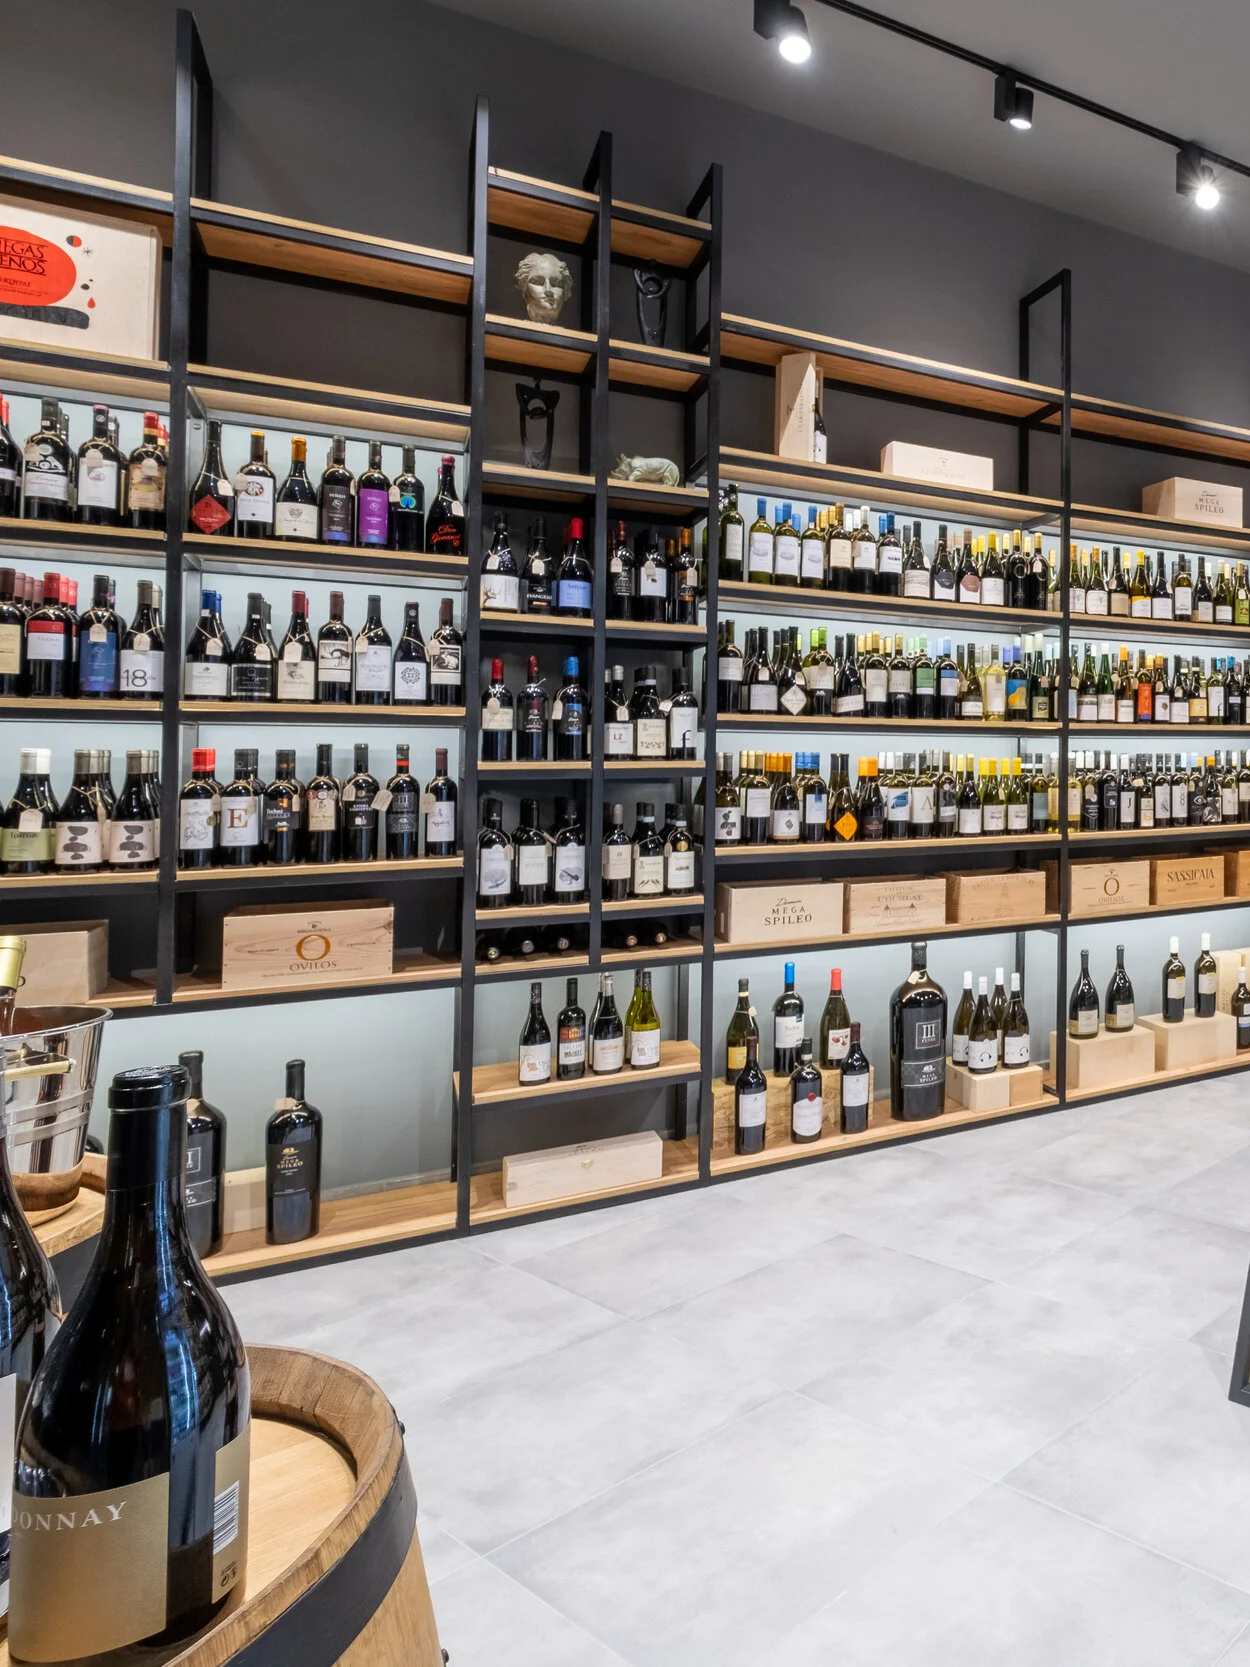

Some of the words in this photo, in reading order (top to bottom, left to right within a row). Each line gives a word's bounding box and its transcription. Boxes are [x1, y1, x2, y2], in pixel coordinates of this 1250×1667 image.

[1198, 497, 1220, 506] MEGA
[1194, 503, 1224, 514] SPILEO
[123, 669, 147, 687] 18
[227, 808, 248, 829] E
[1167, 868, 1215, 883] SASSICAIA
[771, 906, 806, 915] MEGA
[764, 913, 813, 926] SPILEO
[290, 960, 337, 972] OVILOS
